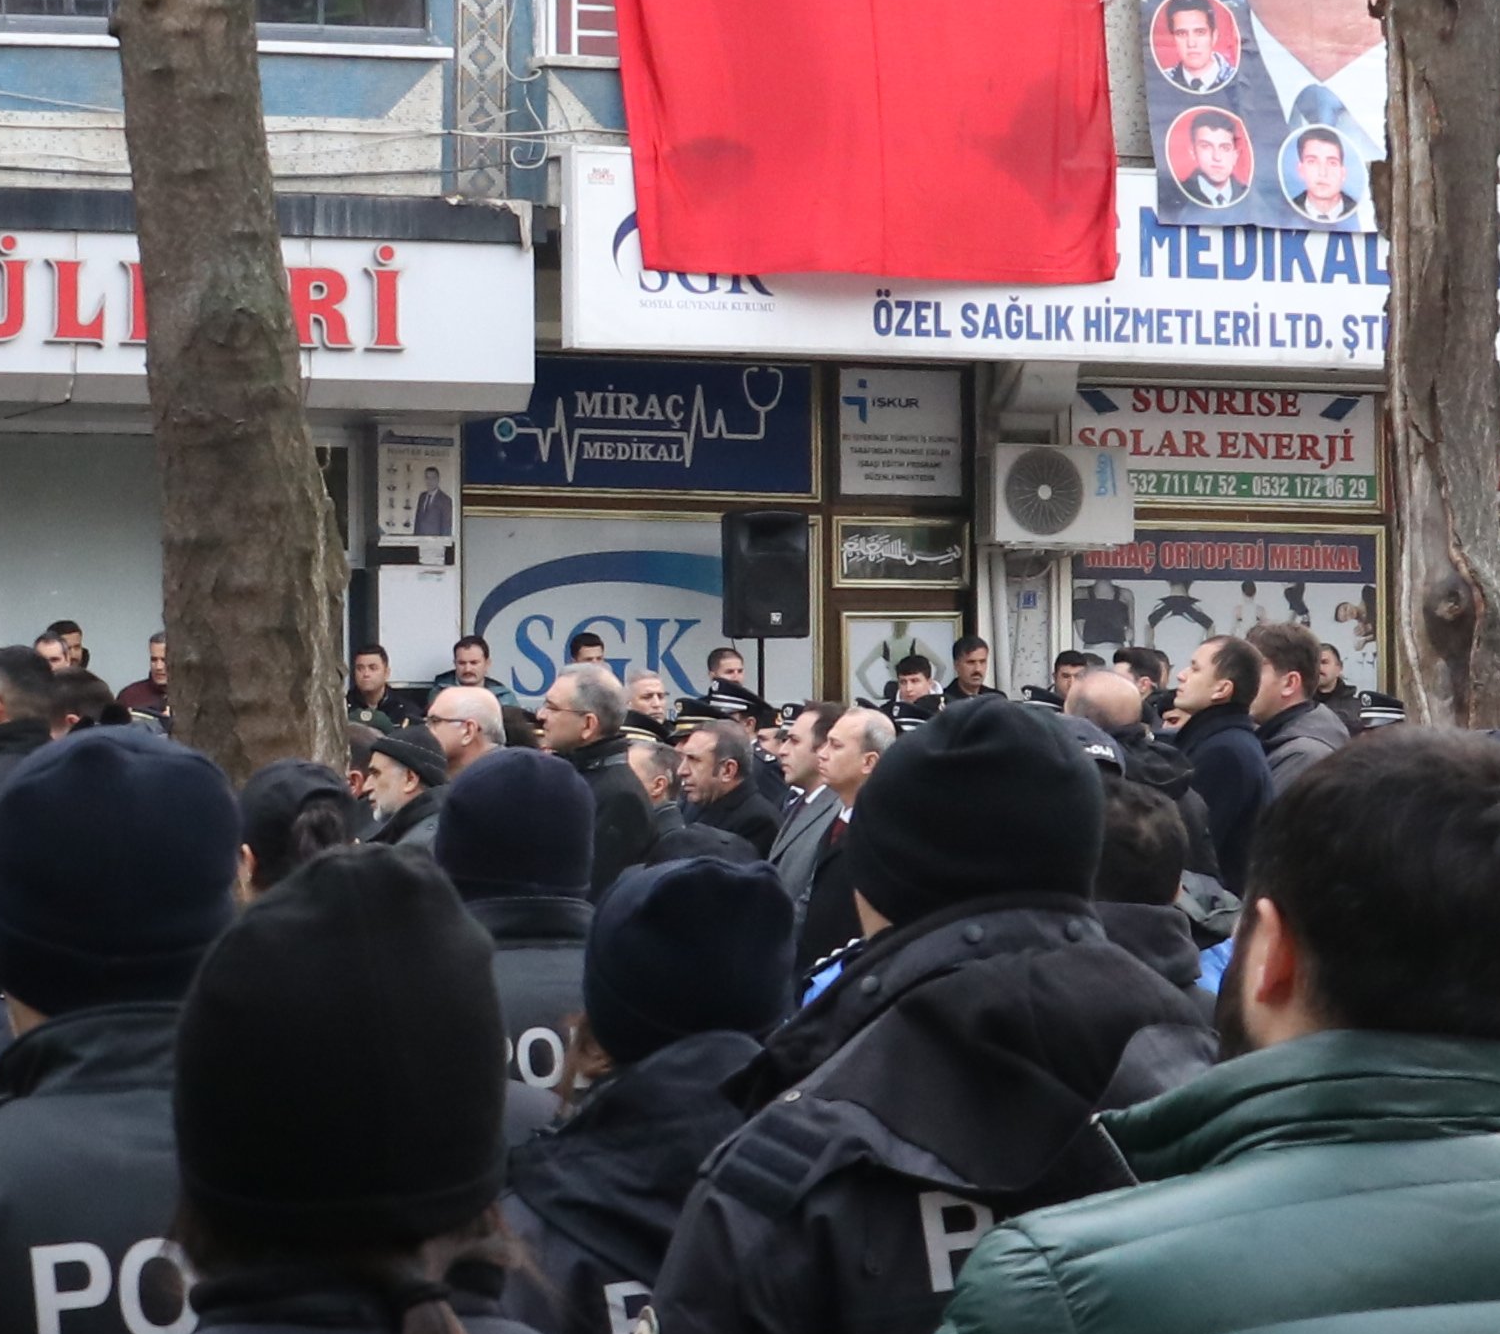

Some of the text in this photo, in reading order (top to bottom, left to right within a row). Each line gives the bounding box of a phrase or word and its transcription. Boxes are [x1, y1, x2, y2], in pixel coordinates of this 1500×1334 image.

[873, 289, 952, 338] ÖZEL
[960, 295, 1075, 341] SAĞLIK
[1083, 297, 1261, 348] HİZMETLERİ
[1269, 312, 1333, 350] LTD.
[574, 384, 686, 429] MİRAÇ
[1132, 386, 1301, 418] SUNRISE
[582, 438, 684, 462] MEDİKAL
[1078, 426, 1355, 470] SOLAR ENERJİ
[1129, 472, 1157, 494] 532
[1162, 473, 1190, 495] 711
[1194, 474, 1214, 495] 47
[1218, 474, 1238, 496] 52
[1252, 475, 1290, 497] 0532
[1295, 476, 1322, 498] 172
[1348, 478, 1368, 498] 29
[1160, 539, 1265, 572] ORTOPEDİ
[1269, 540, 1362, 573] MEDİKAL
[511, 614, 702, 698] SGK
